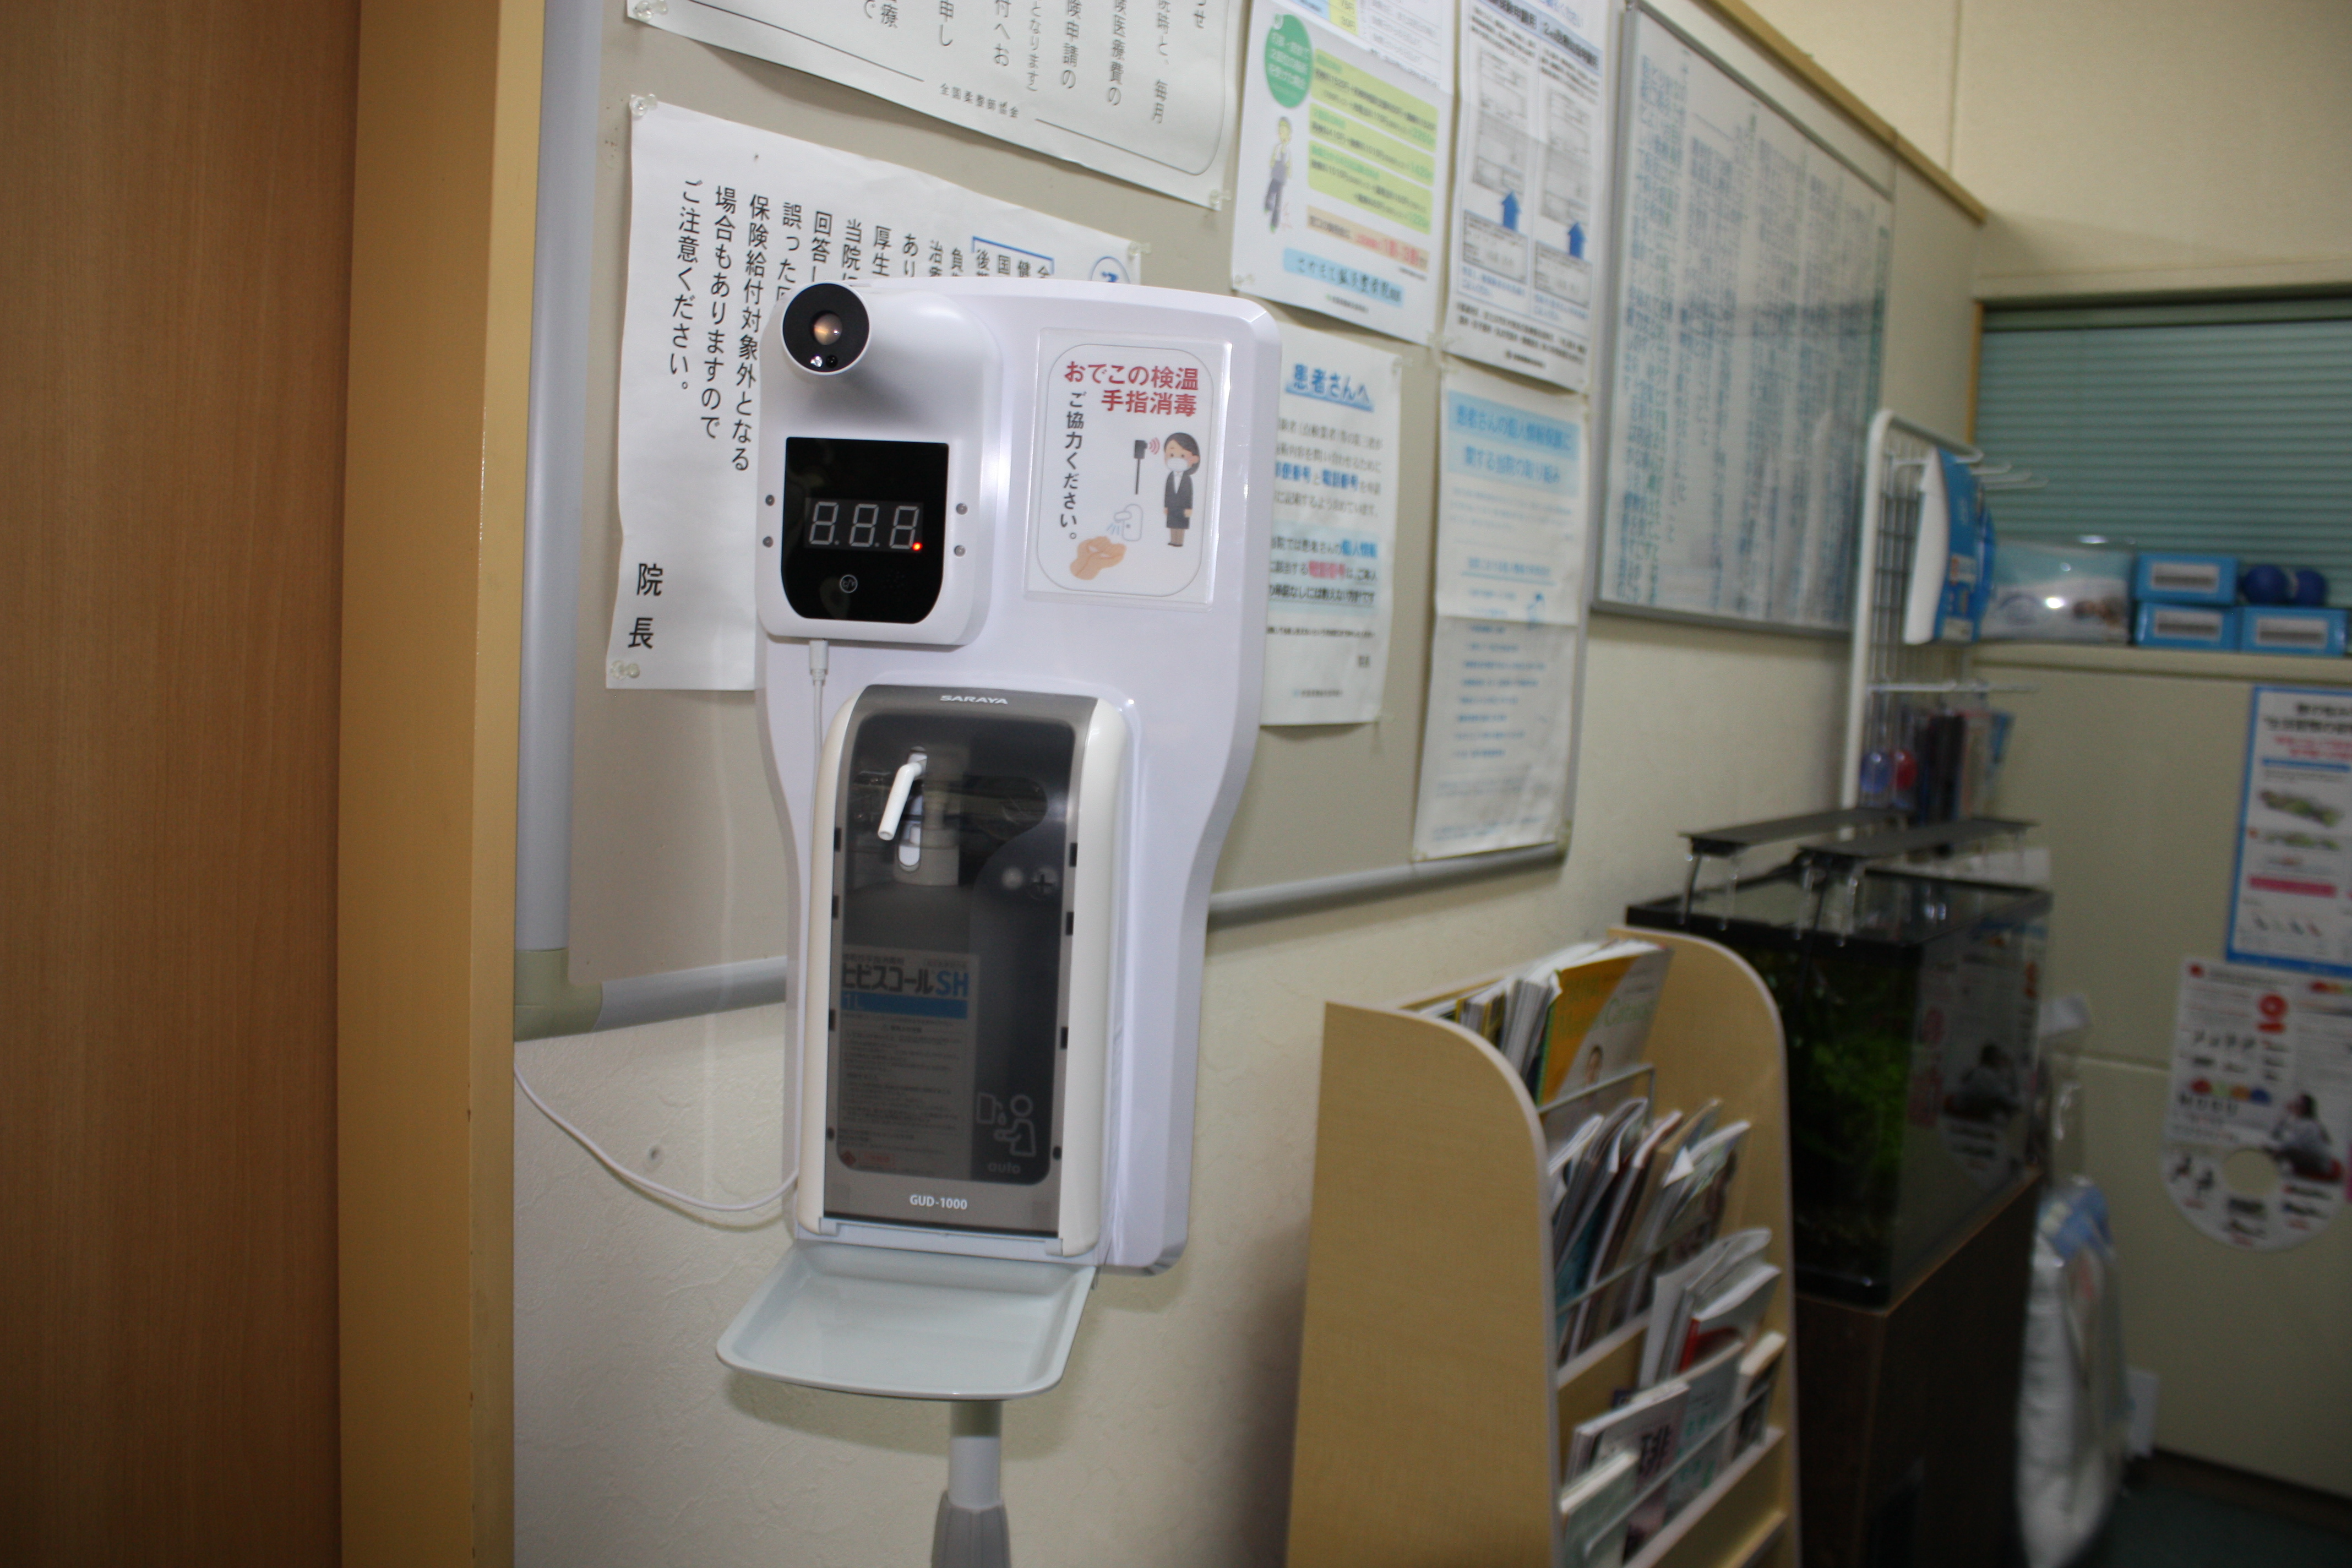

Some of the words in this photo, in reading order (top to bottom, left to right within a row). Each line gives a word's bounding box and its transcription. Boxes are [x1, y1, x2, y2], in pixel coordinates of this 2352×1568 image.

[1193, 0, 1207, 28] せ
[872, 225, 892, 277] 厚生
[951, 247, 964, 276] 負
[975, 248, 990, 276] 後
[669, 179, 703, 390] ご注意ください。
[700, 185, 737, 439] 場合もありますので
[731, 194, 771, 471] 保険給付対象外となる
[1064, 361, 1199, 391] おでこの検温
[1293, 363, 1370, 404] 患者さんへ
[1101, 389, 1197, 417] 手指消毒
[1060, 391, 1087, 541] ご協力ください。
[939, 694, 1009, 705] SARAYA
[909, 1194, 968, 1211] GUD-1000
